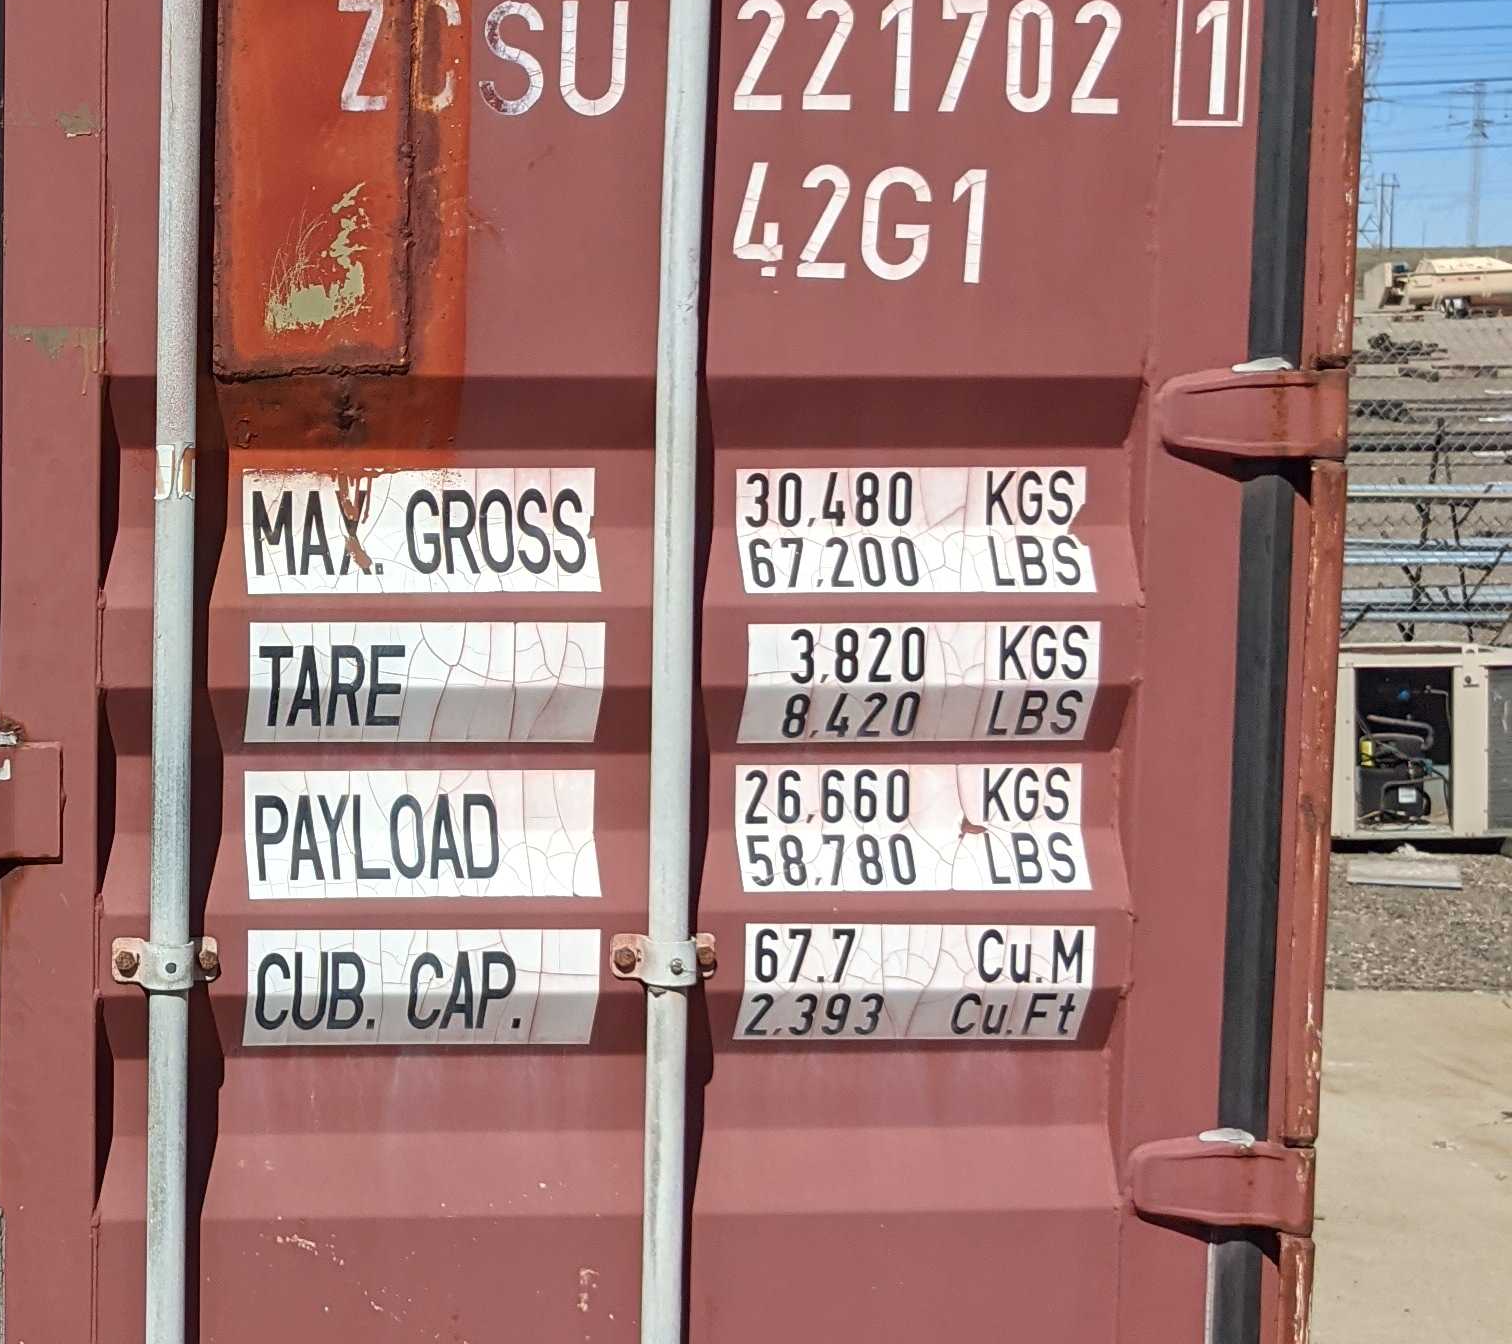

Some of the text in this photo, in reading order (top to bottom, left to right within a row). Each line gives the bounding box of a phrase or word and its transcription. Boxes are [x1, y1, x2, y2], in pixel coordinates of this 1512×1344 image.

[1196, 0, 1230, 116] 1
[734, 162, 987, 283] 42G1
[745, 470, 1075, 528] 30,480 KGS
[252, 489, 587, 577] MAX. GROSS
[749, 535, 1082, 590] 67,200 LBS
[790, 626, 1089, 685] 3,820 KGS
[259, 645, 406, 727] TARE
[781, 690, 1084, 739] 8,420 LBS
[744, 767, 1071, 826] 26,660 KGS
[257, 793, 499, 882] PAYLOAD
[748, 832, 1076, 887] 58,780 LBS
[755, 928, 1084, 984] 67.7 Cu.M
[254, 951, 521, 1031] CUB. CAP.
[745, 993, 1076, 1036] 2,393 Cu.Ft
